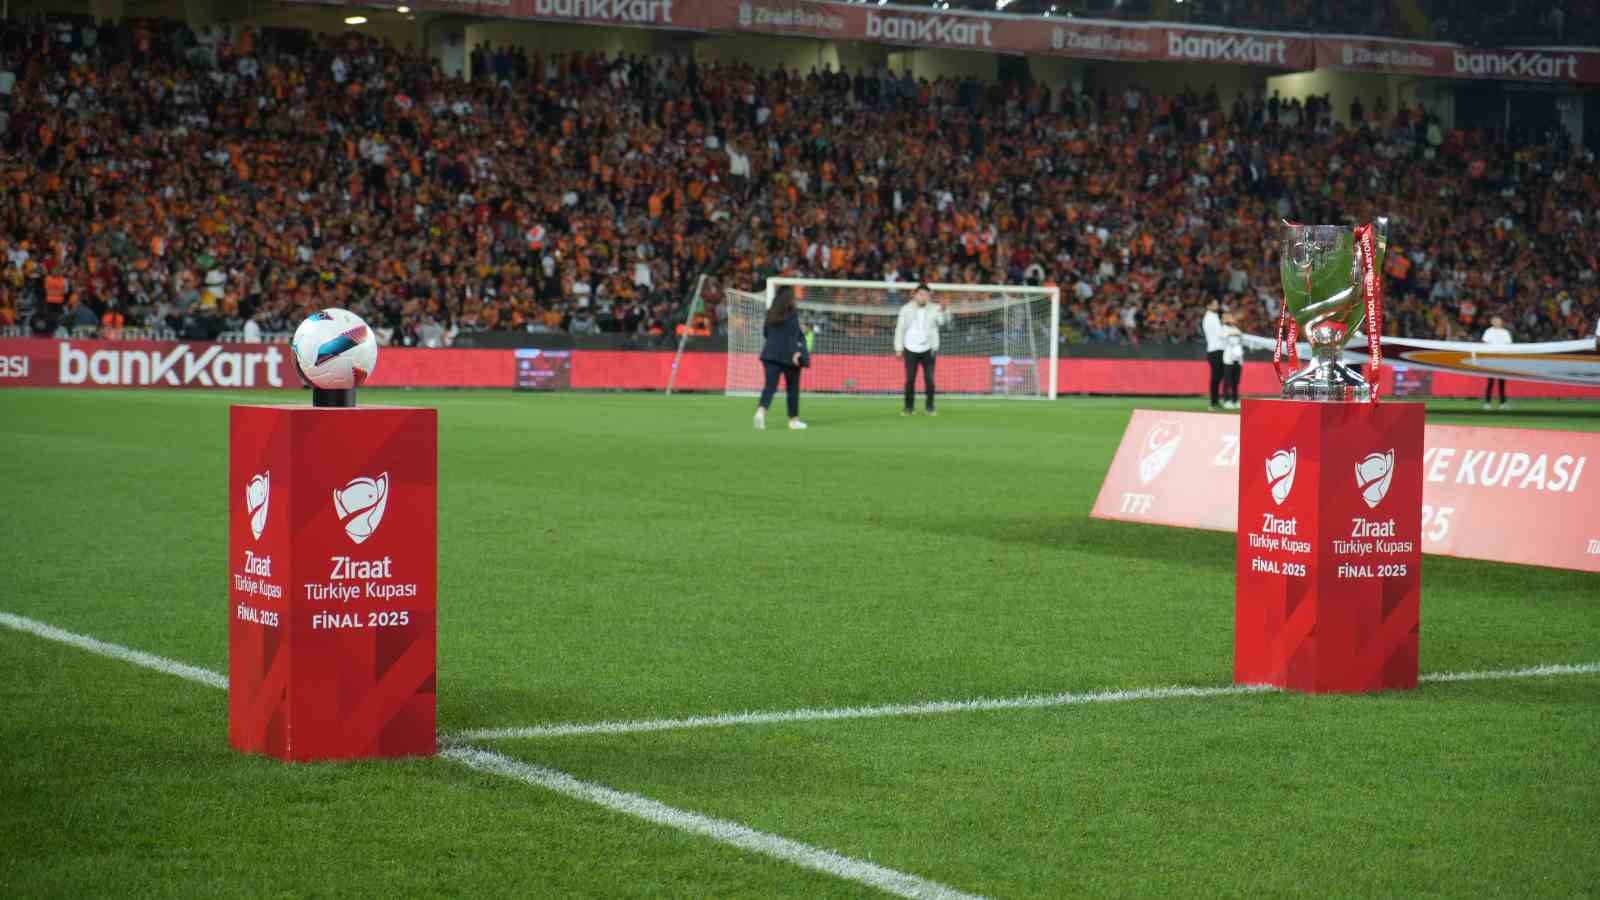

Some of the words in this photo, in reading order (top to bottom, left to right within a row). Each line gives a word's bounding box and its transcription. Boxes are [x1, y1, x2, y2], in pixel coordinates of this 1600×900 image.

[1368, 297, 1377, 332] FUTBOL
[1455, 449, 1587, 492] KUPASI
[1263, 513, 1297, 536] Ziraat
[1351, 518, 1395, 537] Ziraat
[1248, 533, 1279, 553] Türkiye
[1281, 536, 1311, 556] Kupası
[1332, 540, 1372, 557] Türkiye
[1376, 539, 1413, 556] Kupası
[245, 550, 272, 577] Ziraat
[330, 556, 392, 580] Ziraat
[1252, 556, 1280, 574] FİNAL
[1282, 563, 1306, 577] 2025
[1338, 562, 1374, 578] FİNAL
[1377, 564, 1407, 577] 2025
[234, 574, 257, 597] Türkiye
[259, 579, 282, 601] Kupası
[304, 583, 360, 602] Türkiye
[366, 582, 417, 601] Kupası
[237, 601, 259, 624] FİNAL
[260, 610, 279, 627] 2025
[312, 610, 364, 629] FİNAL
[368, 611, 409, 627] 2025
